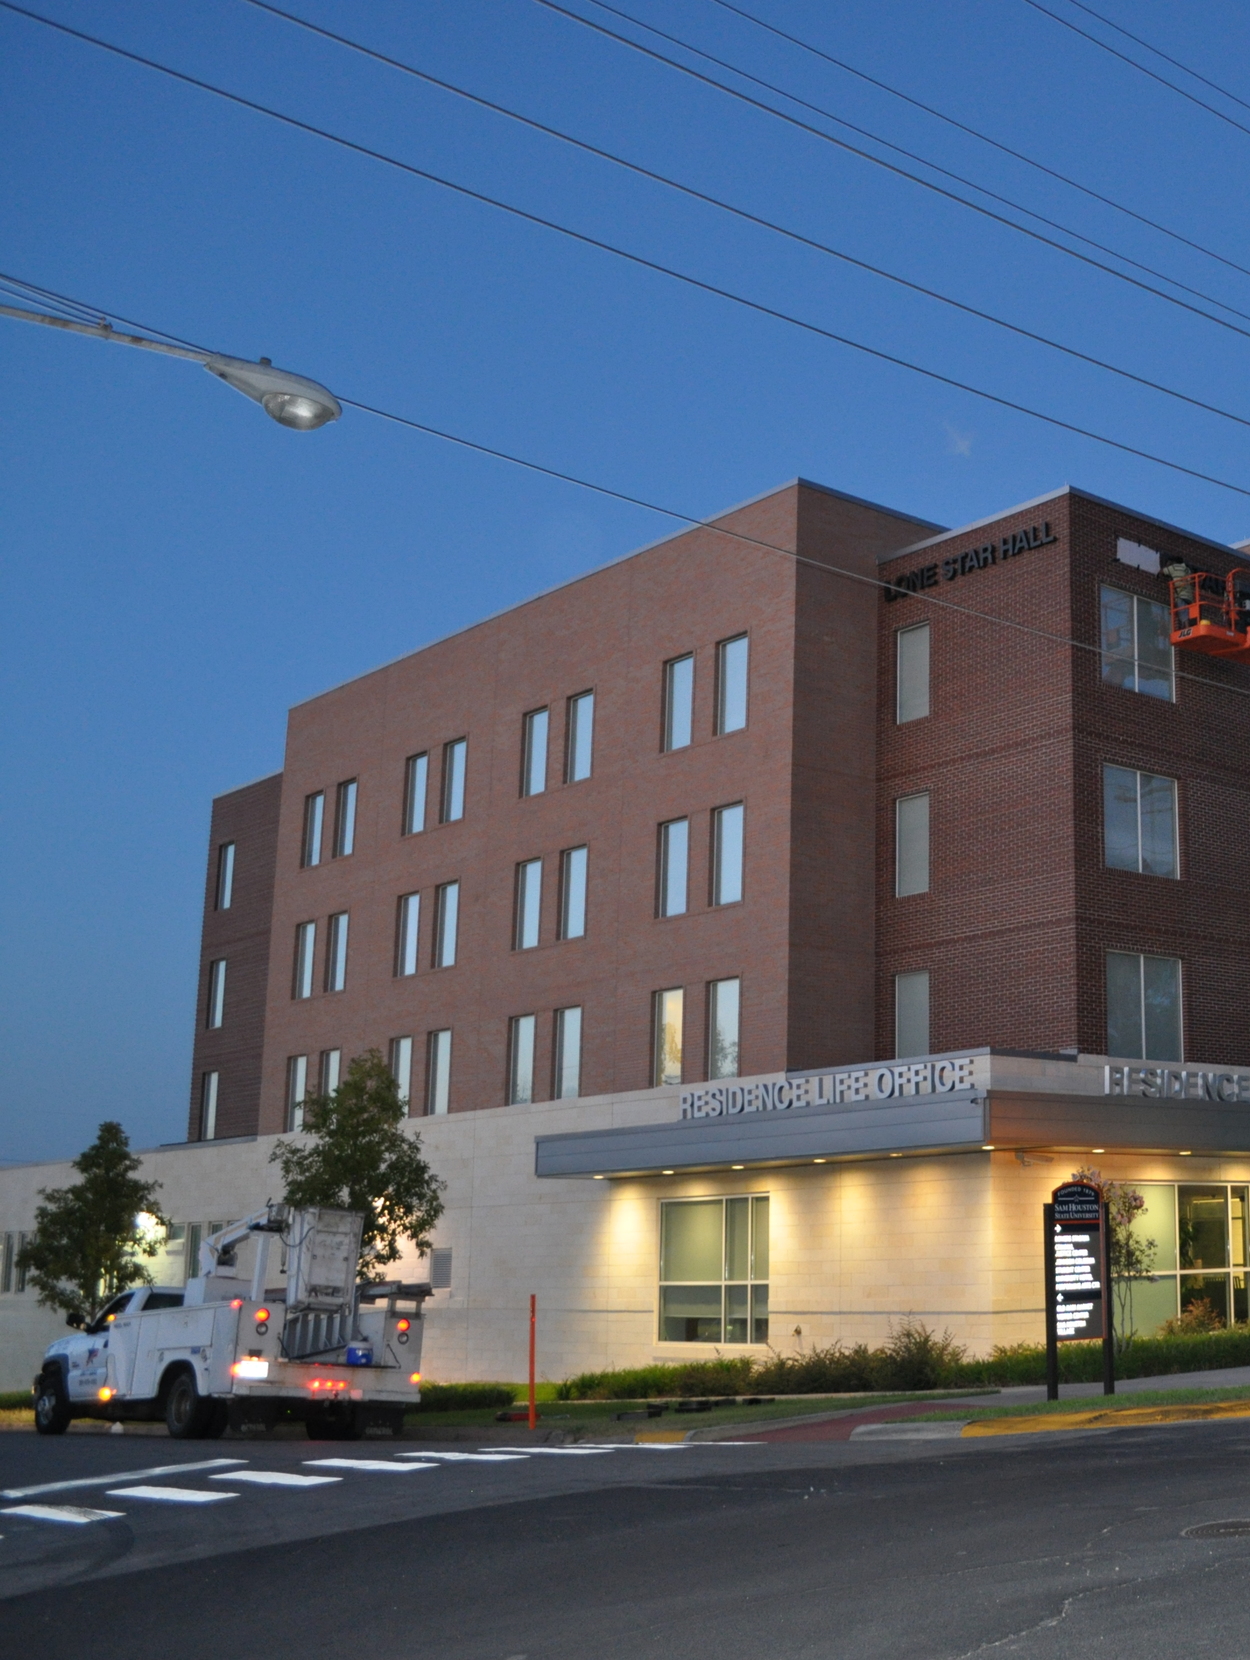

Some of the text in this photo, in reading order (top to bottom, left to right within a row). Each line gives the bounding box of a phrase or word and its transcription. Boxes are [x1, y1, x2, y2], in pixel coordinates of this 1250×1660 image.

[883, 521, 1057, 602] LONE STAR HALL
[1178, 628, 1193, 639] JLG
[680, 1058, 976, 1120] RESIDENCE LIFE OFFICE
[1057, 1186, 1095, 1197] FOUNDED 1879
[1054, 1203, 1099, 1212] SAM HOUSTON
